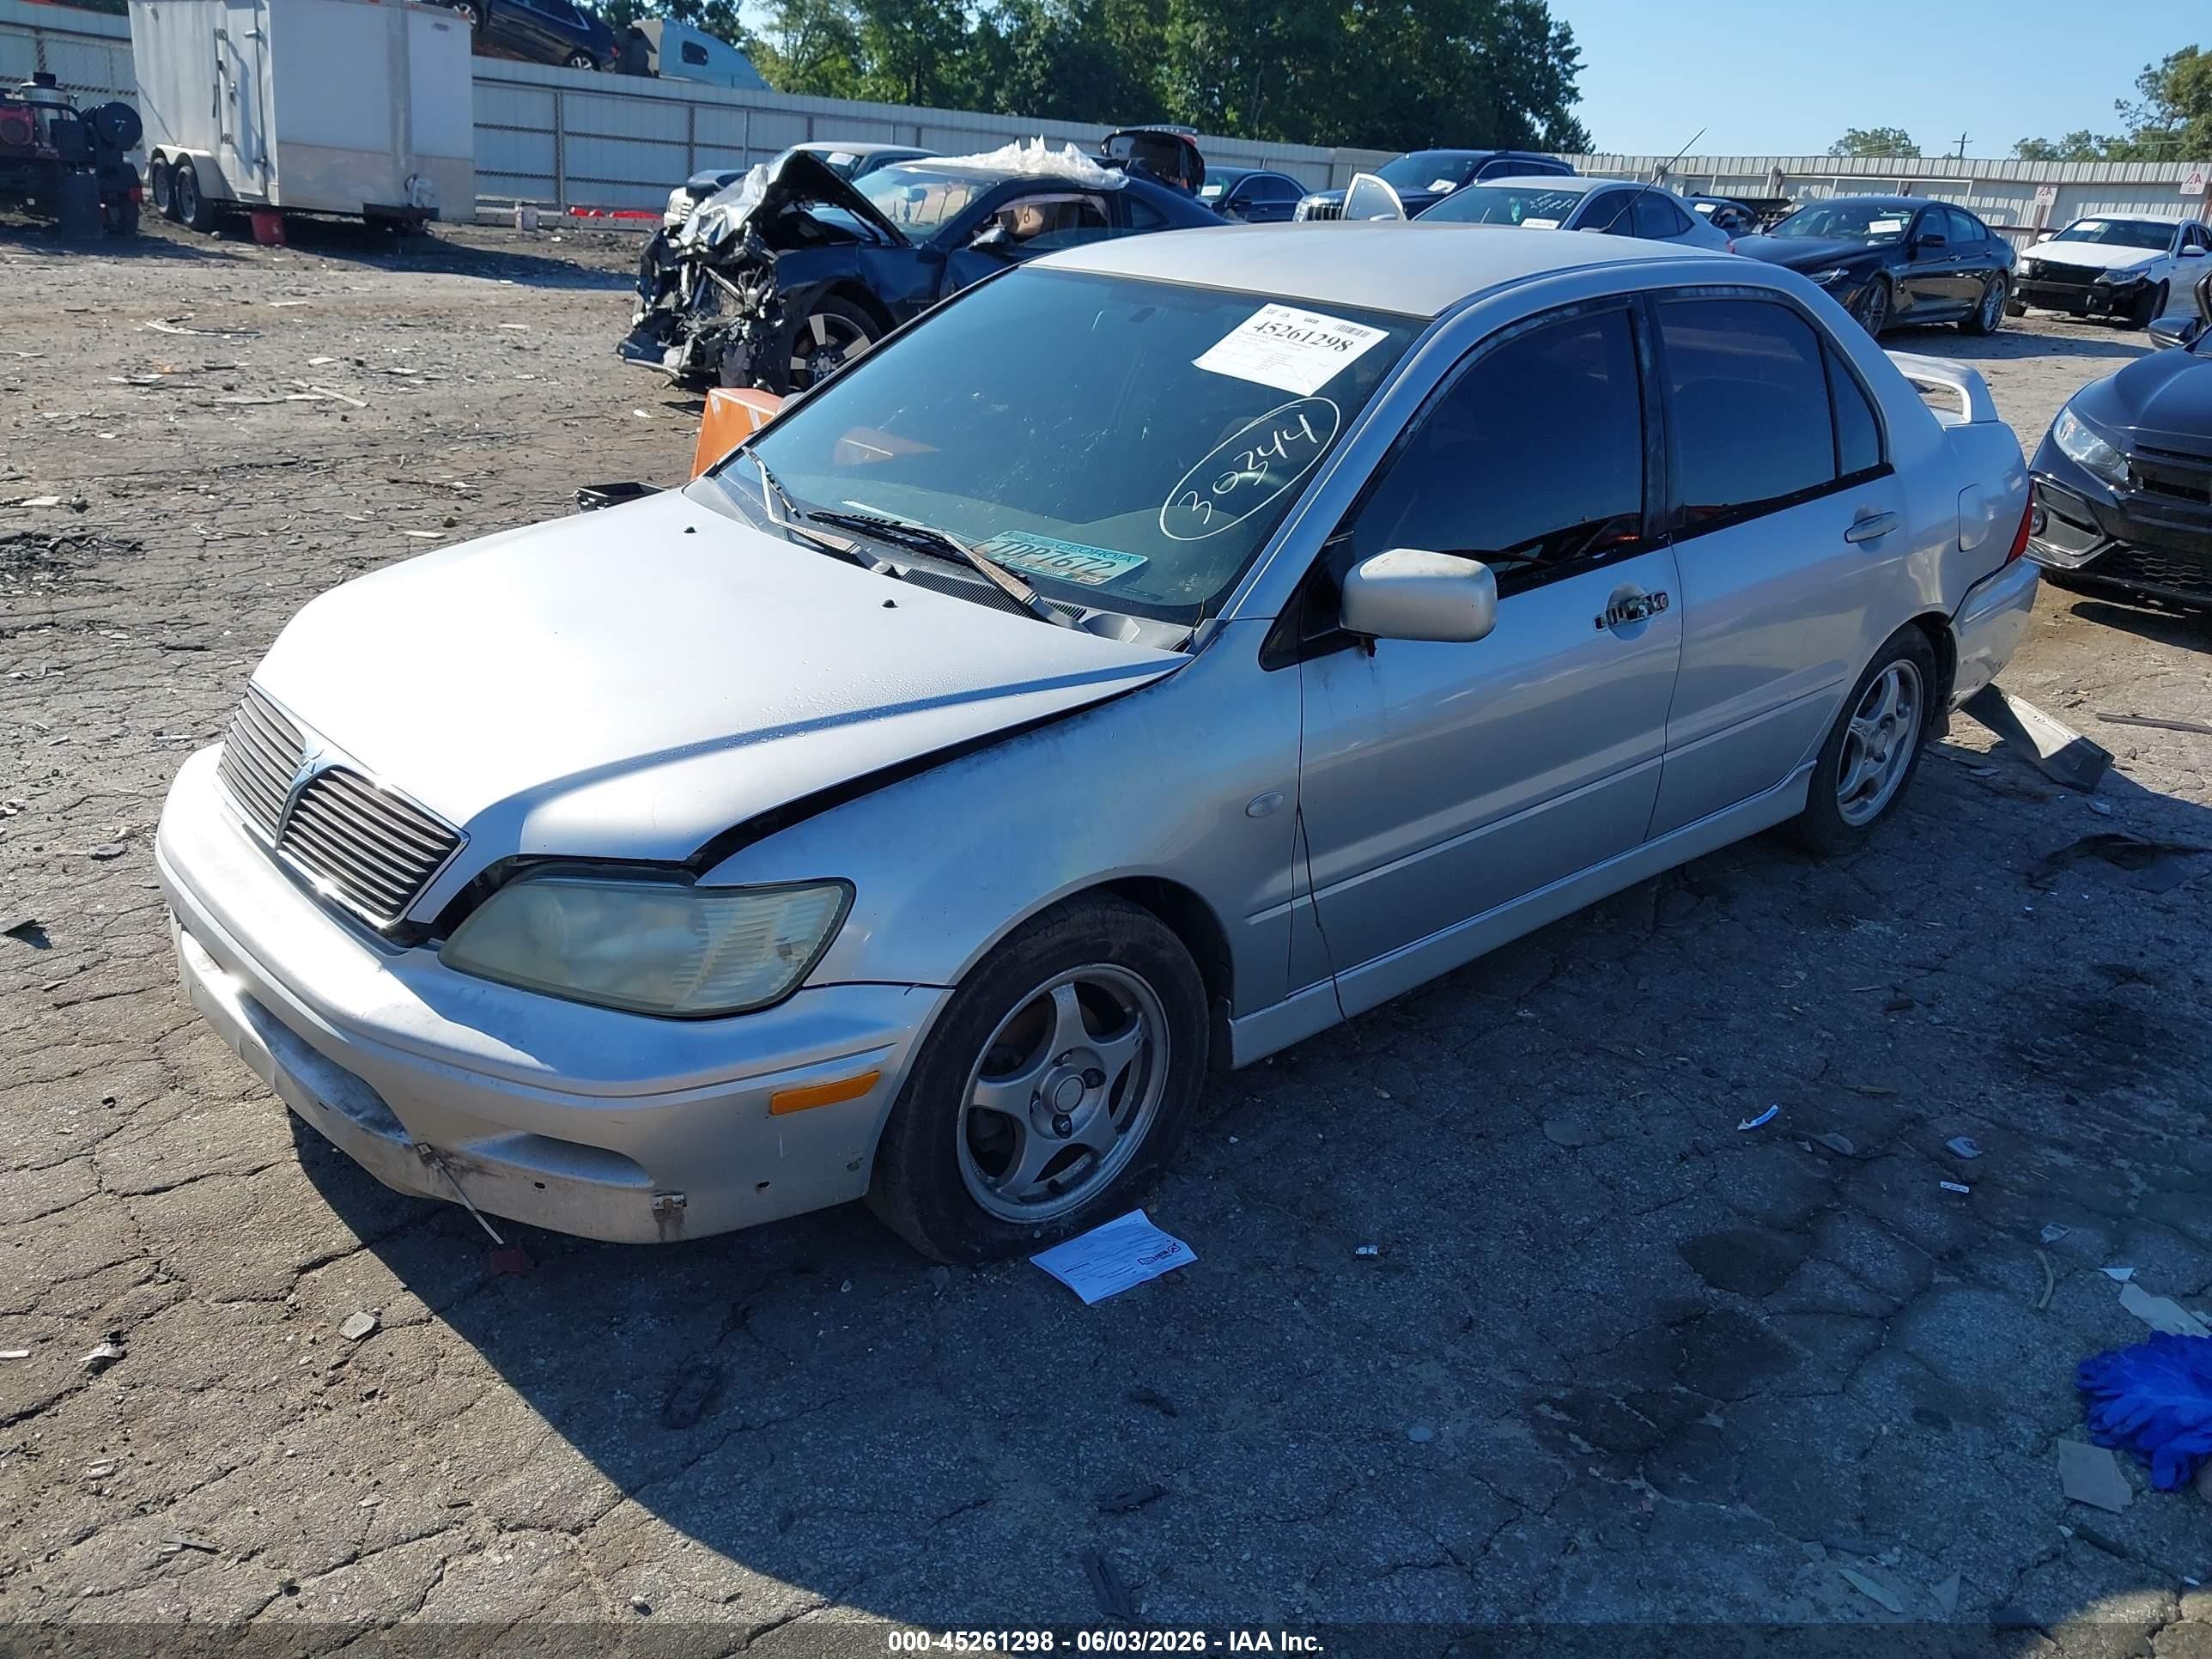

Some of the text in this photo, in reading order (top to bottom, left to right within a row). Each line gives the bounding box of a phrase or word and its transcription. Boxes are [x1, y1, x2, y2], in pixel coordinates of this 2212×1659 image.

[1254, 321, 1354, 352] 45261298
[1177, 414, 1319, 526] 30344
[990, 540, 1117, 574] TDP7672
[1056, 543, 1135, 563] GEORGIA
